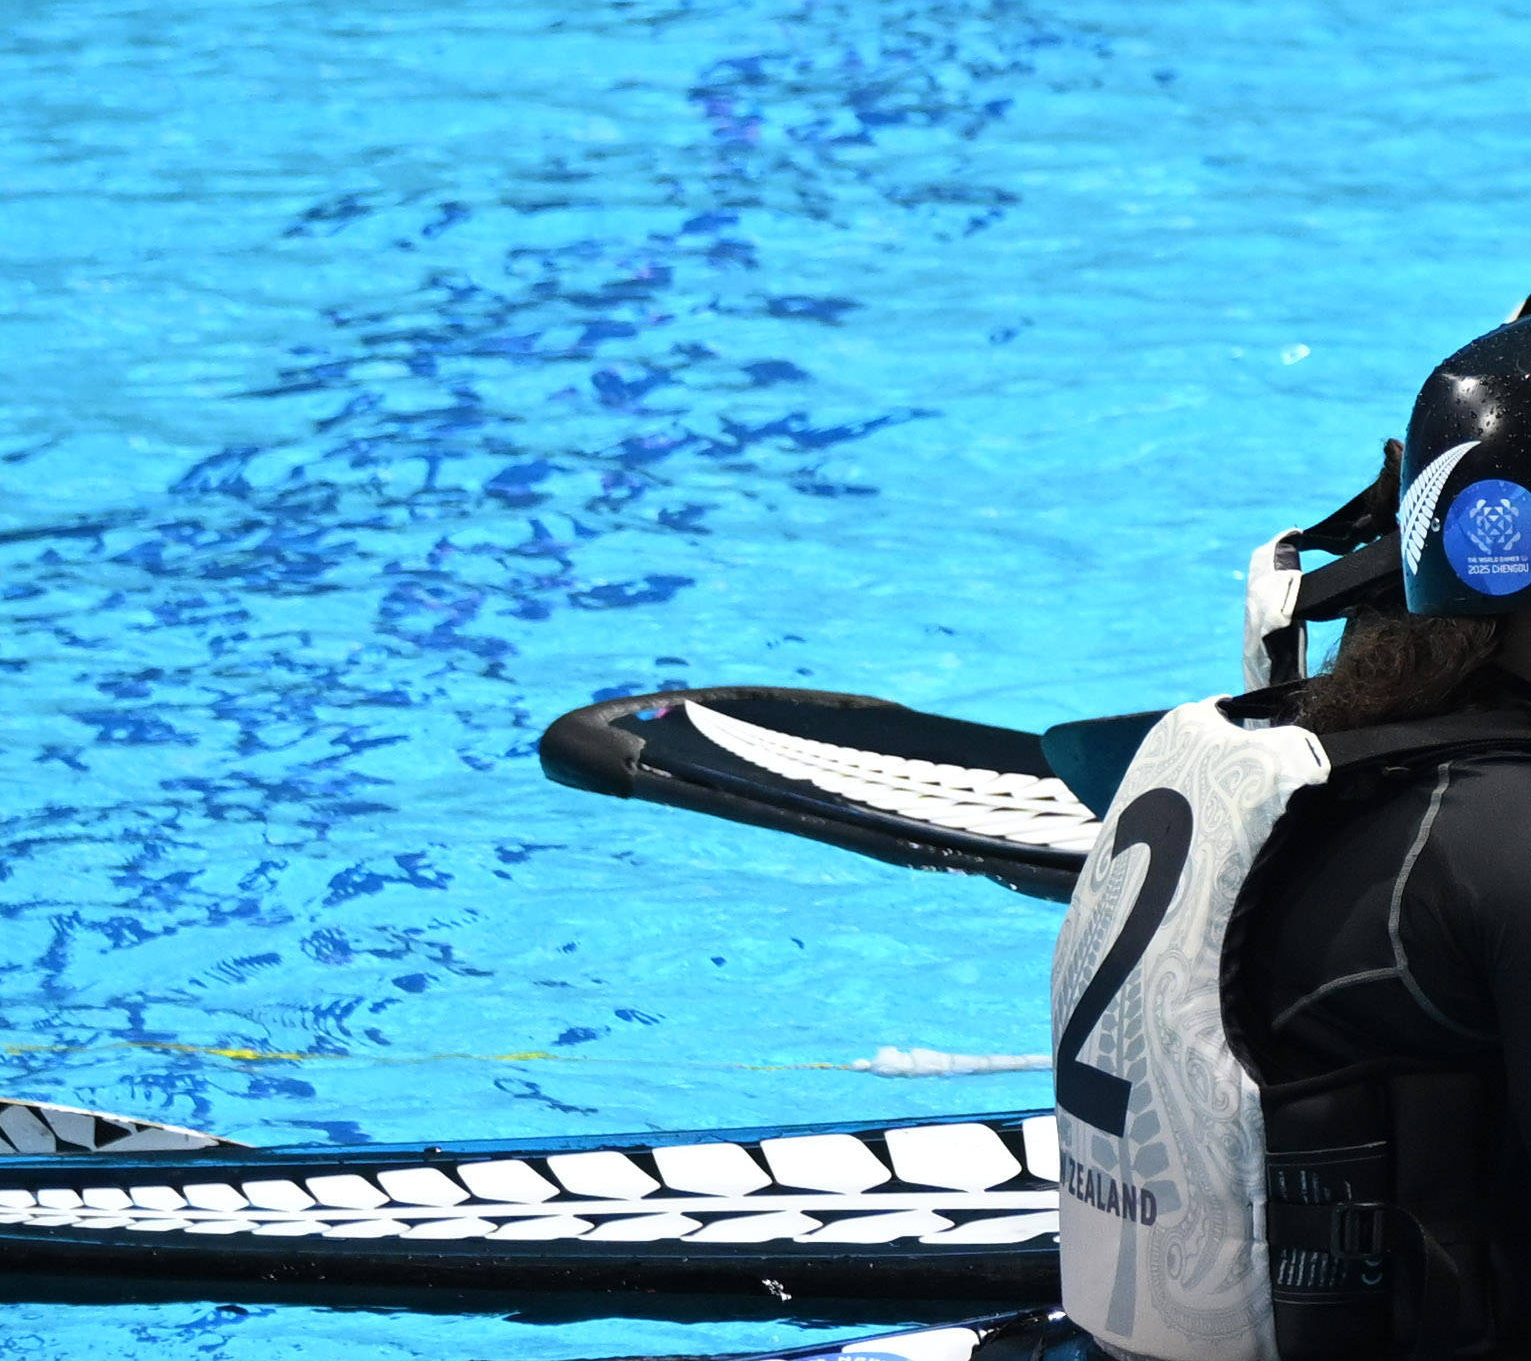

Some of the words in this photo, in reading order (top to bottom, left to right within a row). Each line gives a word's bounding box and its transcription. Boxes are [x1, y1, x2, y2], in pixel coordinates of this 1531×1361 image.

[1468, 565, 1490, 575] 2025
[1056, 787, 1193, 1138] 2
[1067, 1162, 1157, 1226] ZEALAND
